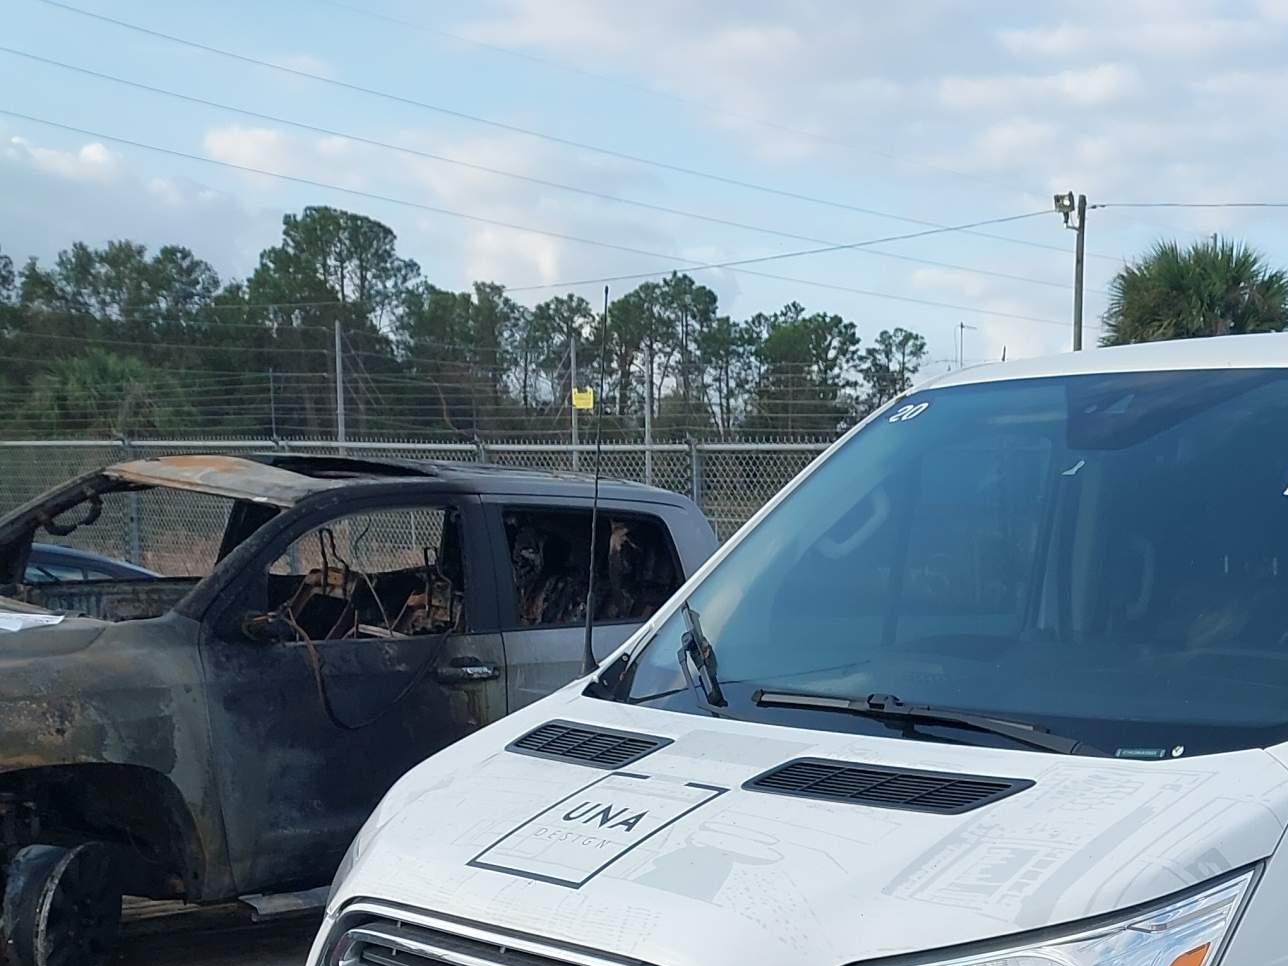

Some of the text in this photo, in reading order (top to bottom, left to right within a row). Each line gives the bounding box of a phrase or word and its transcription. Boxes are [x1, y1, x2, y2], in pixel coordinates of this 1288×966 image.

[888, 402, 929, 422] 20
[562, 801, 649, 832] UNA
[534, 828, 611, 849] DESIGN
